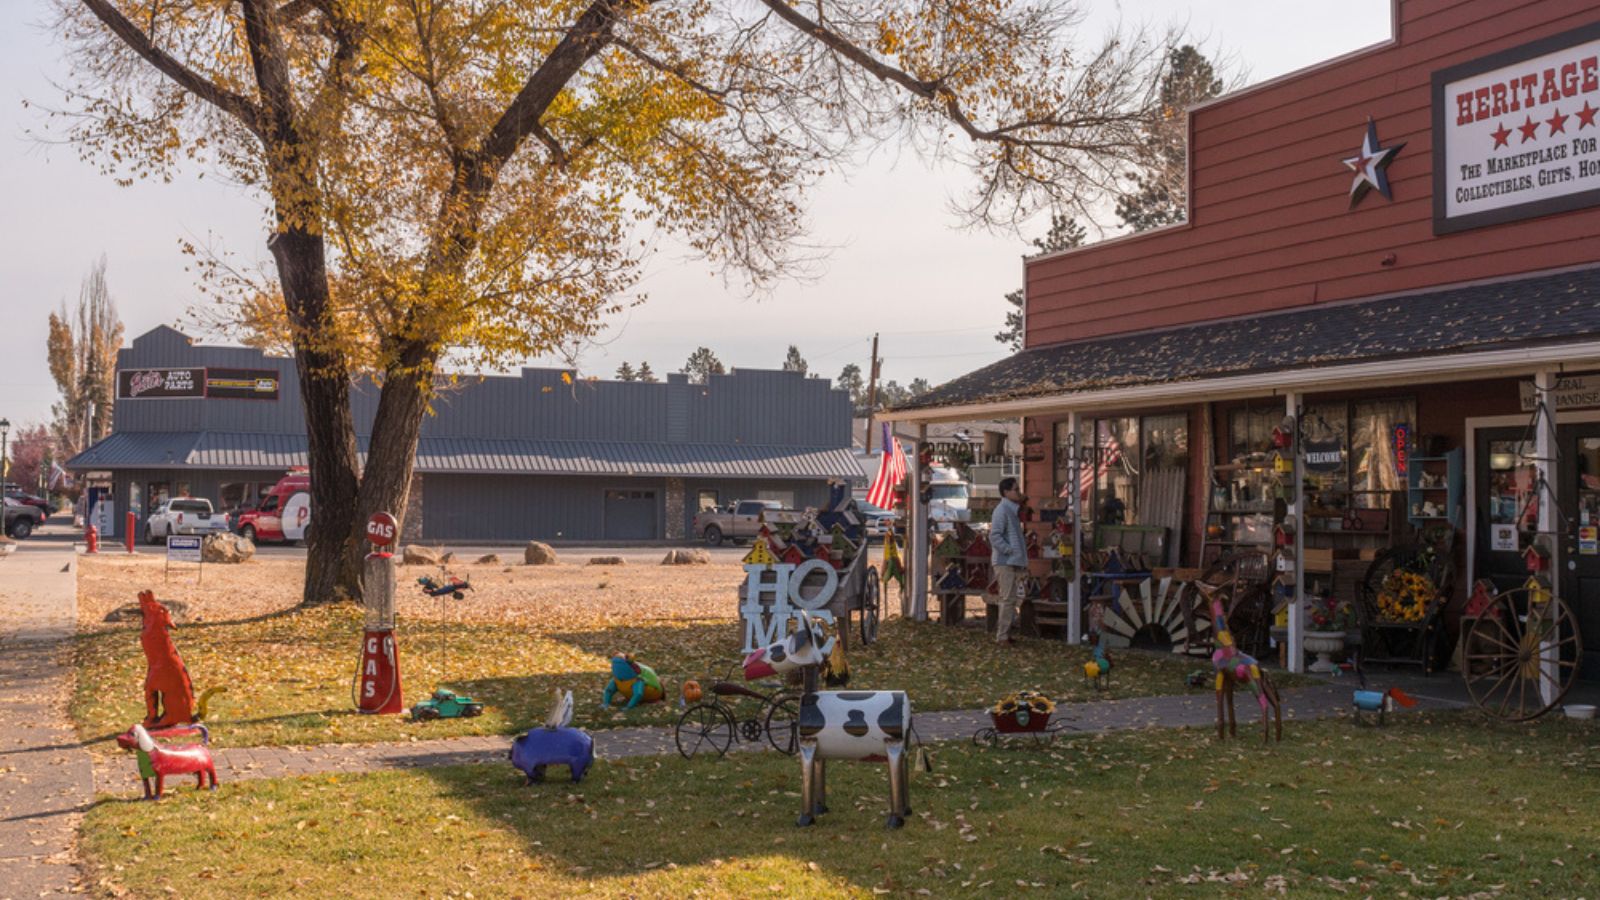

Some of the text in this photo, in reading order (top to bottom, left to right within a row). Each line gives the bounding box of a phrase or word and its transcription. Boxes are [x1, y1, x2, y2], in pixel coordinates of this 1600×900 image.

[1456, 56, 1599, 126] HERITAGE
[1461, 138, 1597, 180] THE MARKETPLACE FOR
[1456, 175, 1535, 203] COLLECTIBLES,
[167, 371, 191, 380] AUTO
[1306, 451, 1341, 464] WELCOME
[1395, 428, 1406, 473] OPEN
[367, 520, 393, 538] GAS
[741, 559, 839, 613] HO
[365, 637, 377, 698] GAS
